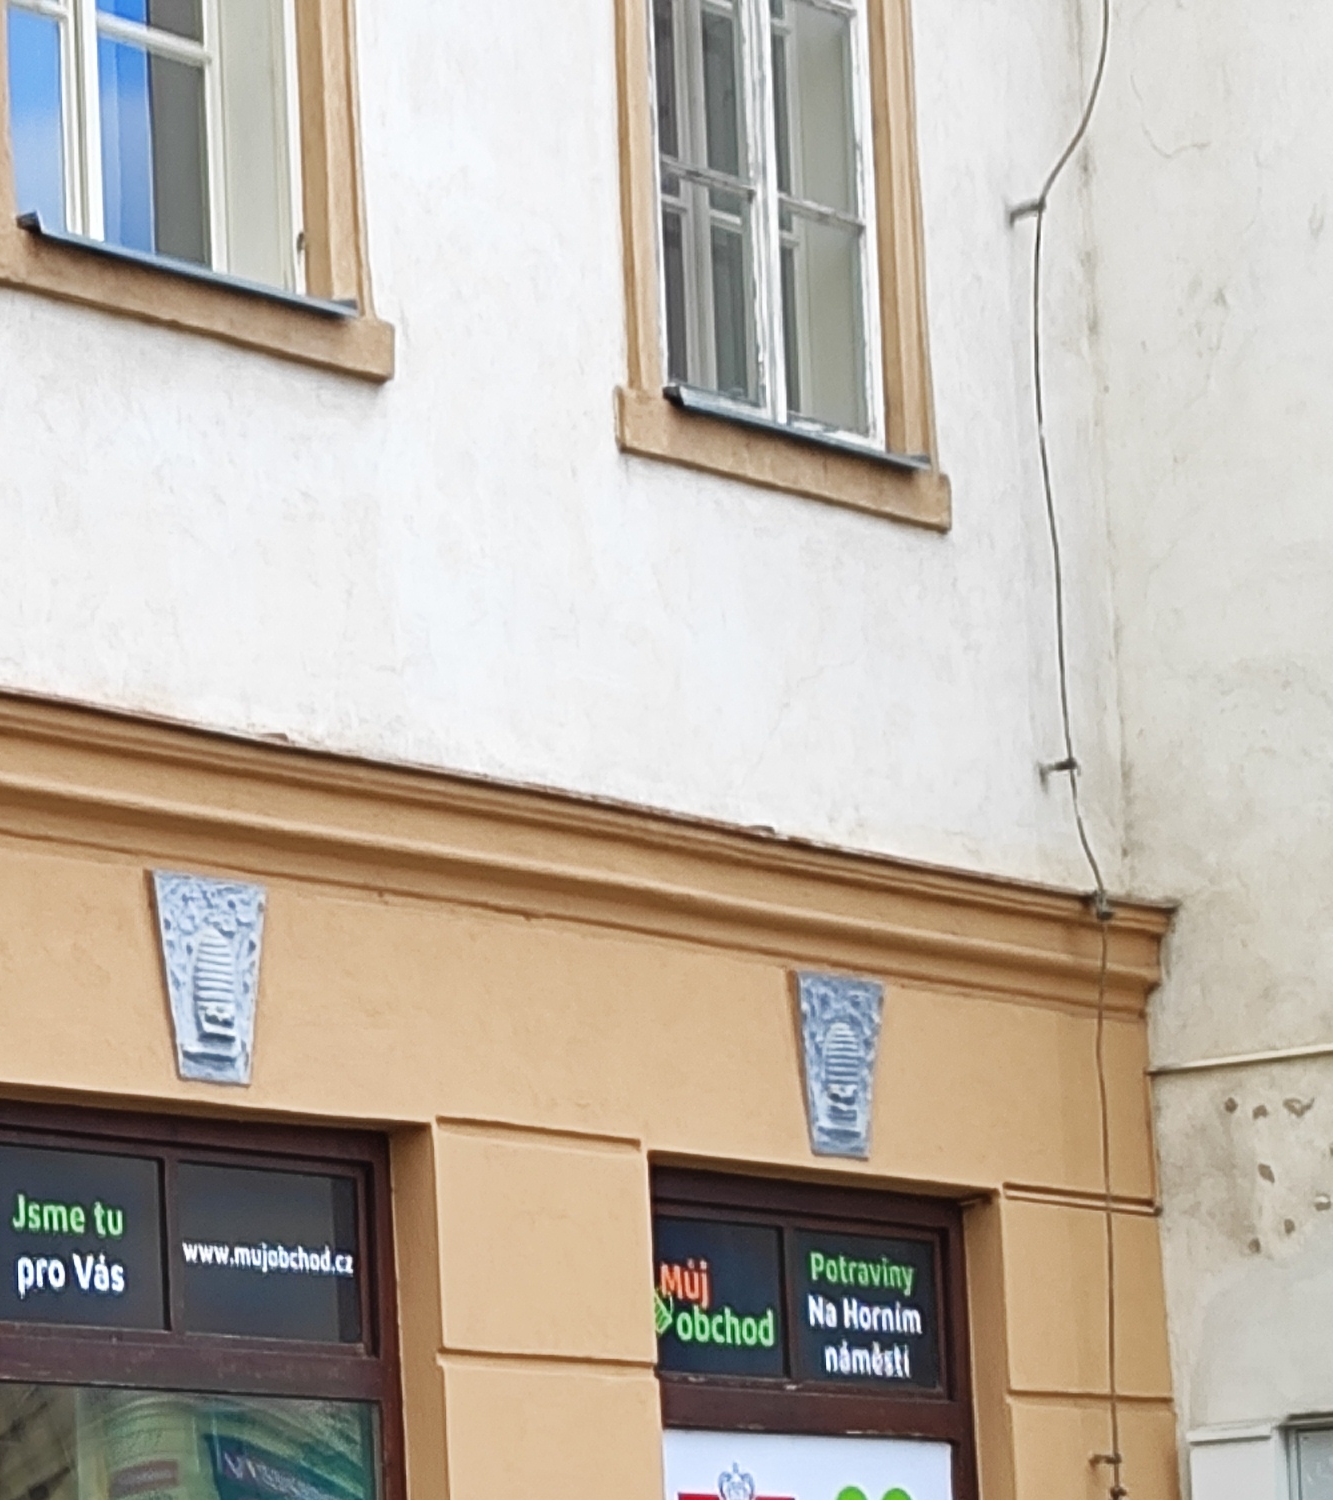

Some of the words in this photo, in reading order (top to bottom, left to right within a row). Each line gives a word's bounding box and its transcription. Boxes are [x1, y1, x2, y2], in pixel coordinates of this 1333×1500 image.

[12, 1194, 85, 1234] Jsme
[94, 1202, 124, 1237] tu
[17, 1255, 65, 1299] pro
[73, 1251, 125, 1293] Vás
[182, 1241, 354, 1276] www.mujobchod.cz
[810, 1251, 914, 1296] Potraviny
[660, 1258, 709, 1310] Můj
[676, 1303, 774, 1347] obchod
[808, 1294, 838, 1328] Na
